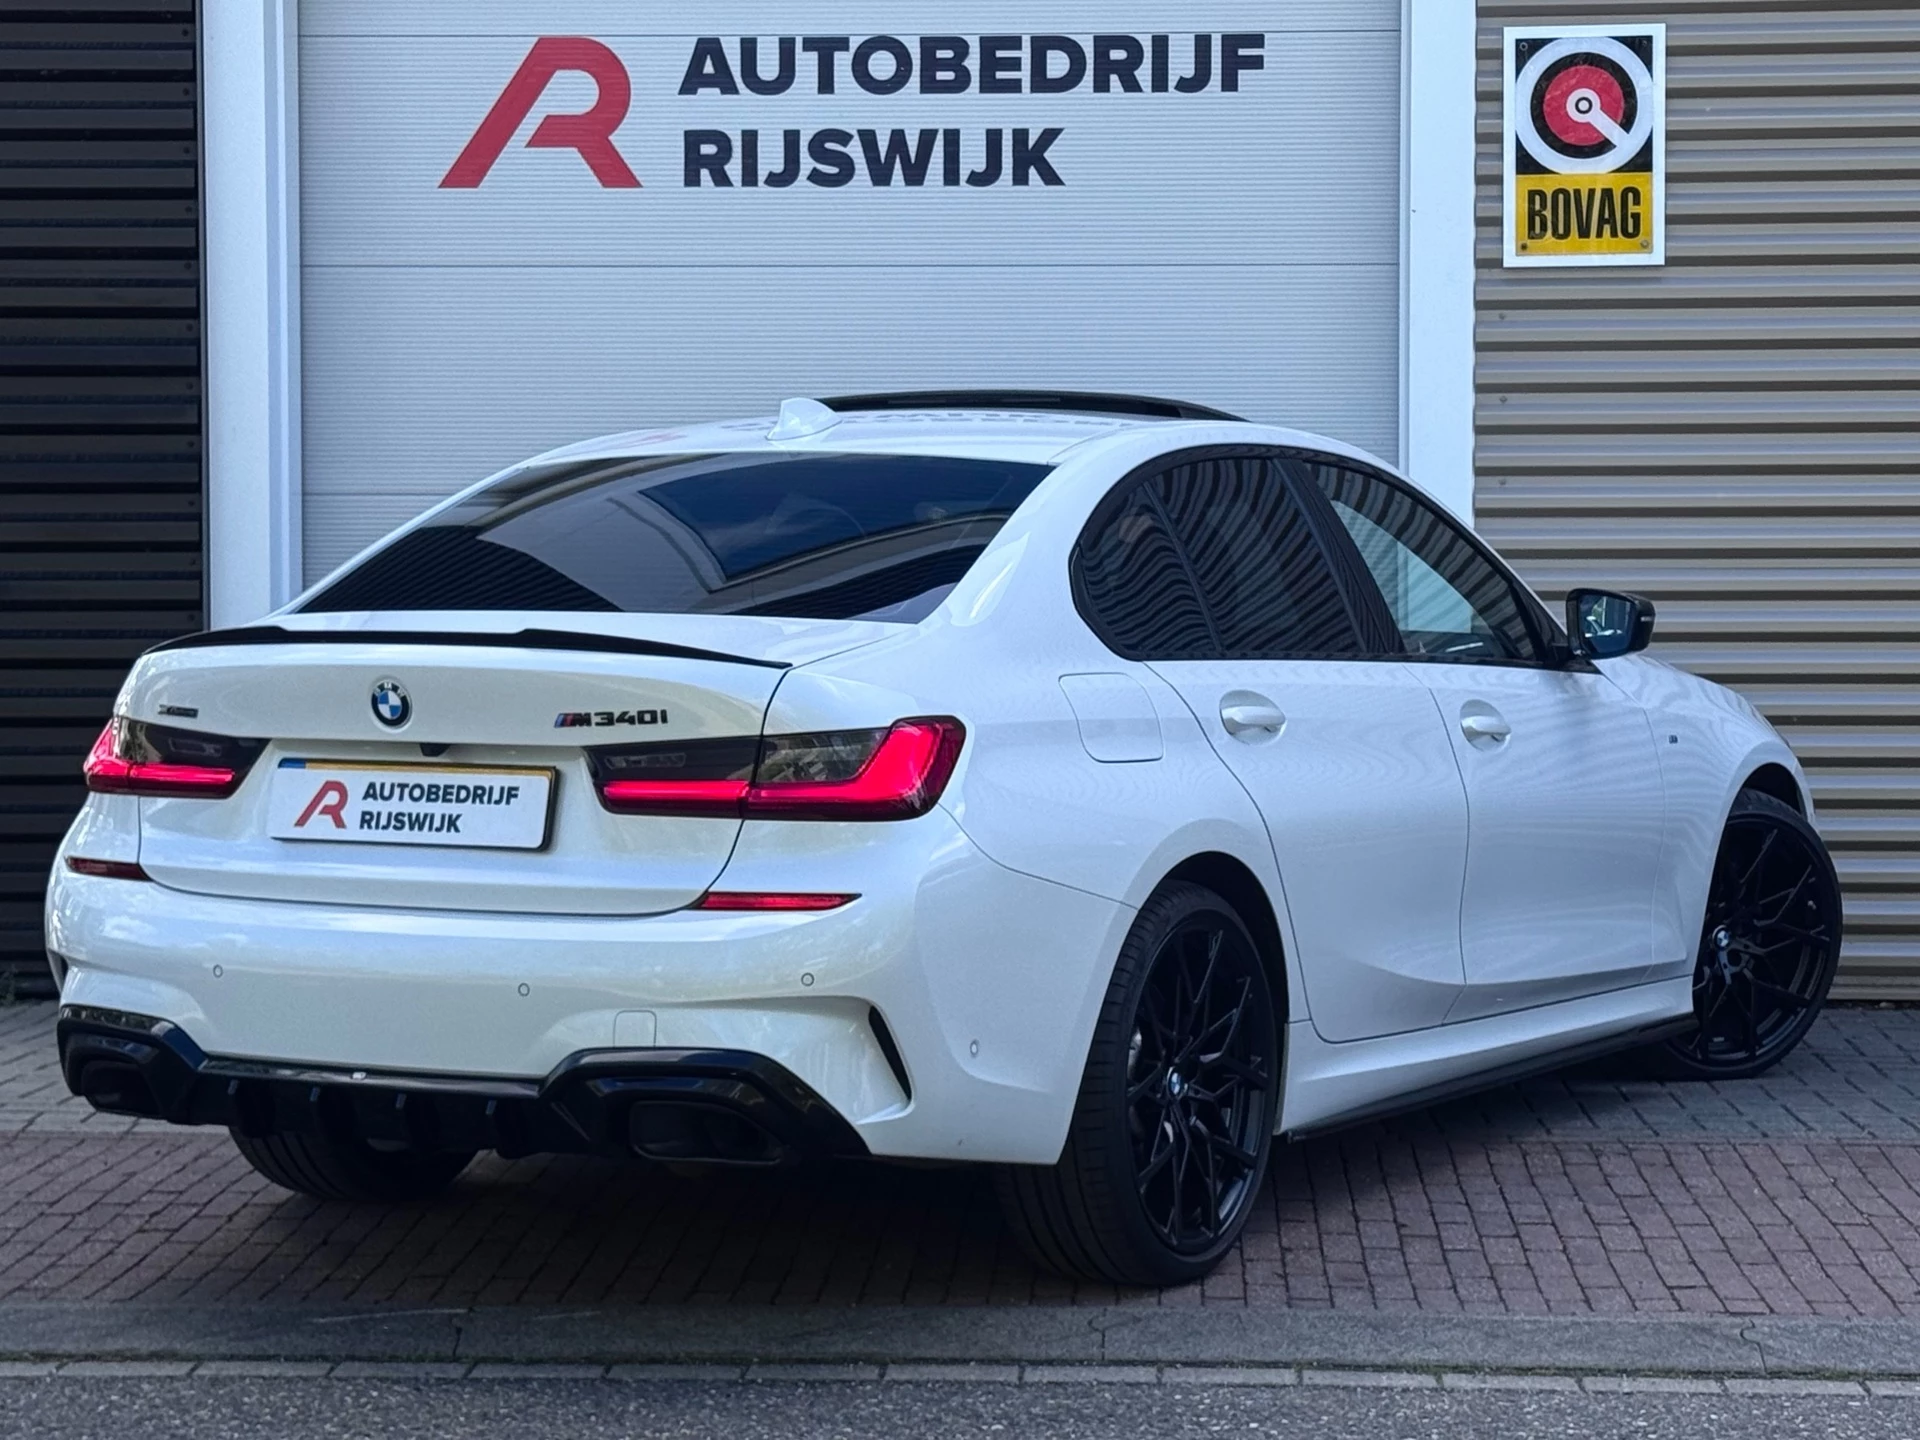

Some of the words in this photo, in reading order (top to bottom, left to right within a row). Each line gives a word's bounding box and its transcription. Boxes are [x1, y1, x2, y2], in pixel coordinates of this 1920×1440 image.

[678, 34, 1265, 95] AUTOBEDRIJF
[683, 128, 1065, 188] RIJSWIJK
[1527, 186, 1641, 240] BOVAG
[362, 781, 520, 805] AUTOBEDRIJF
[359, 811, 462, 833] RIJSWIJK
